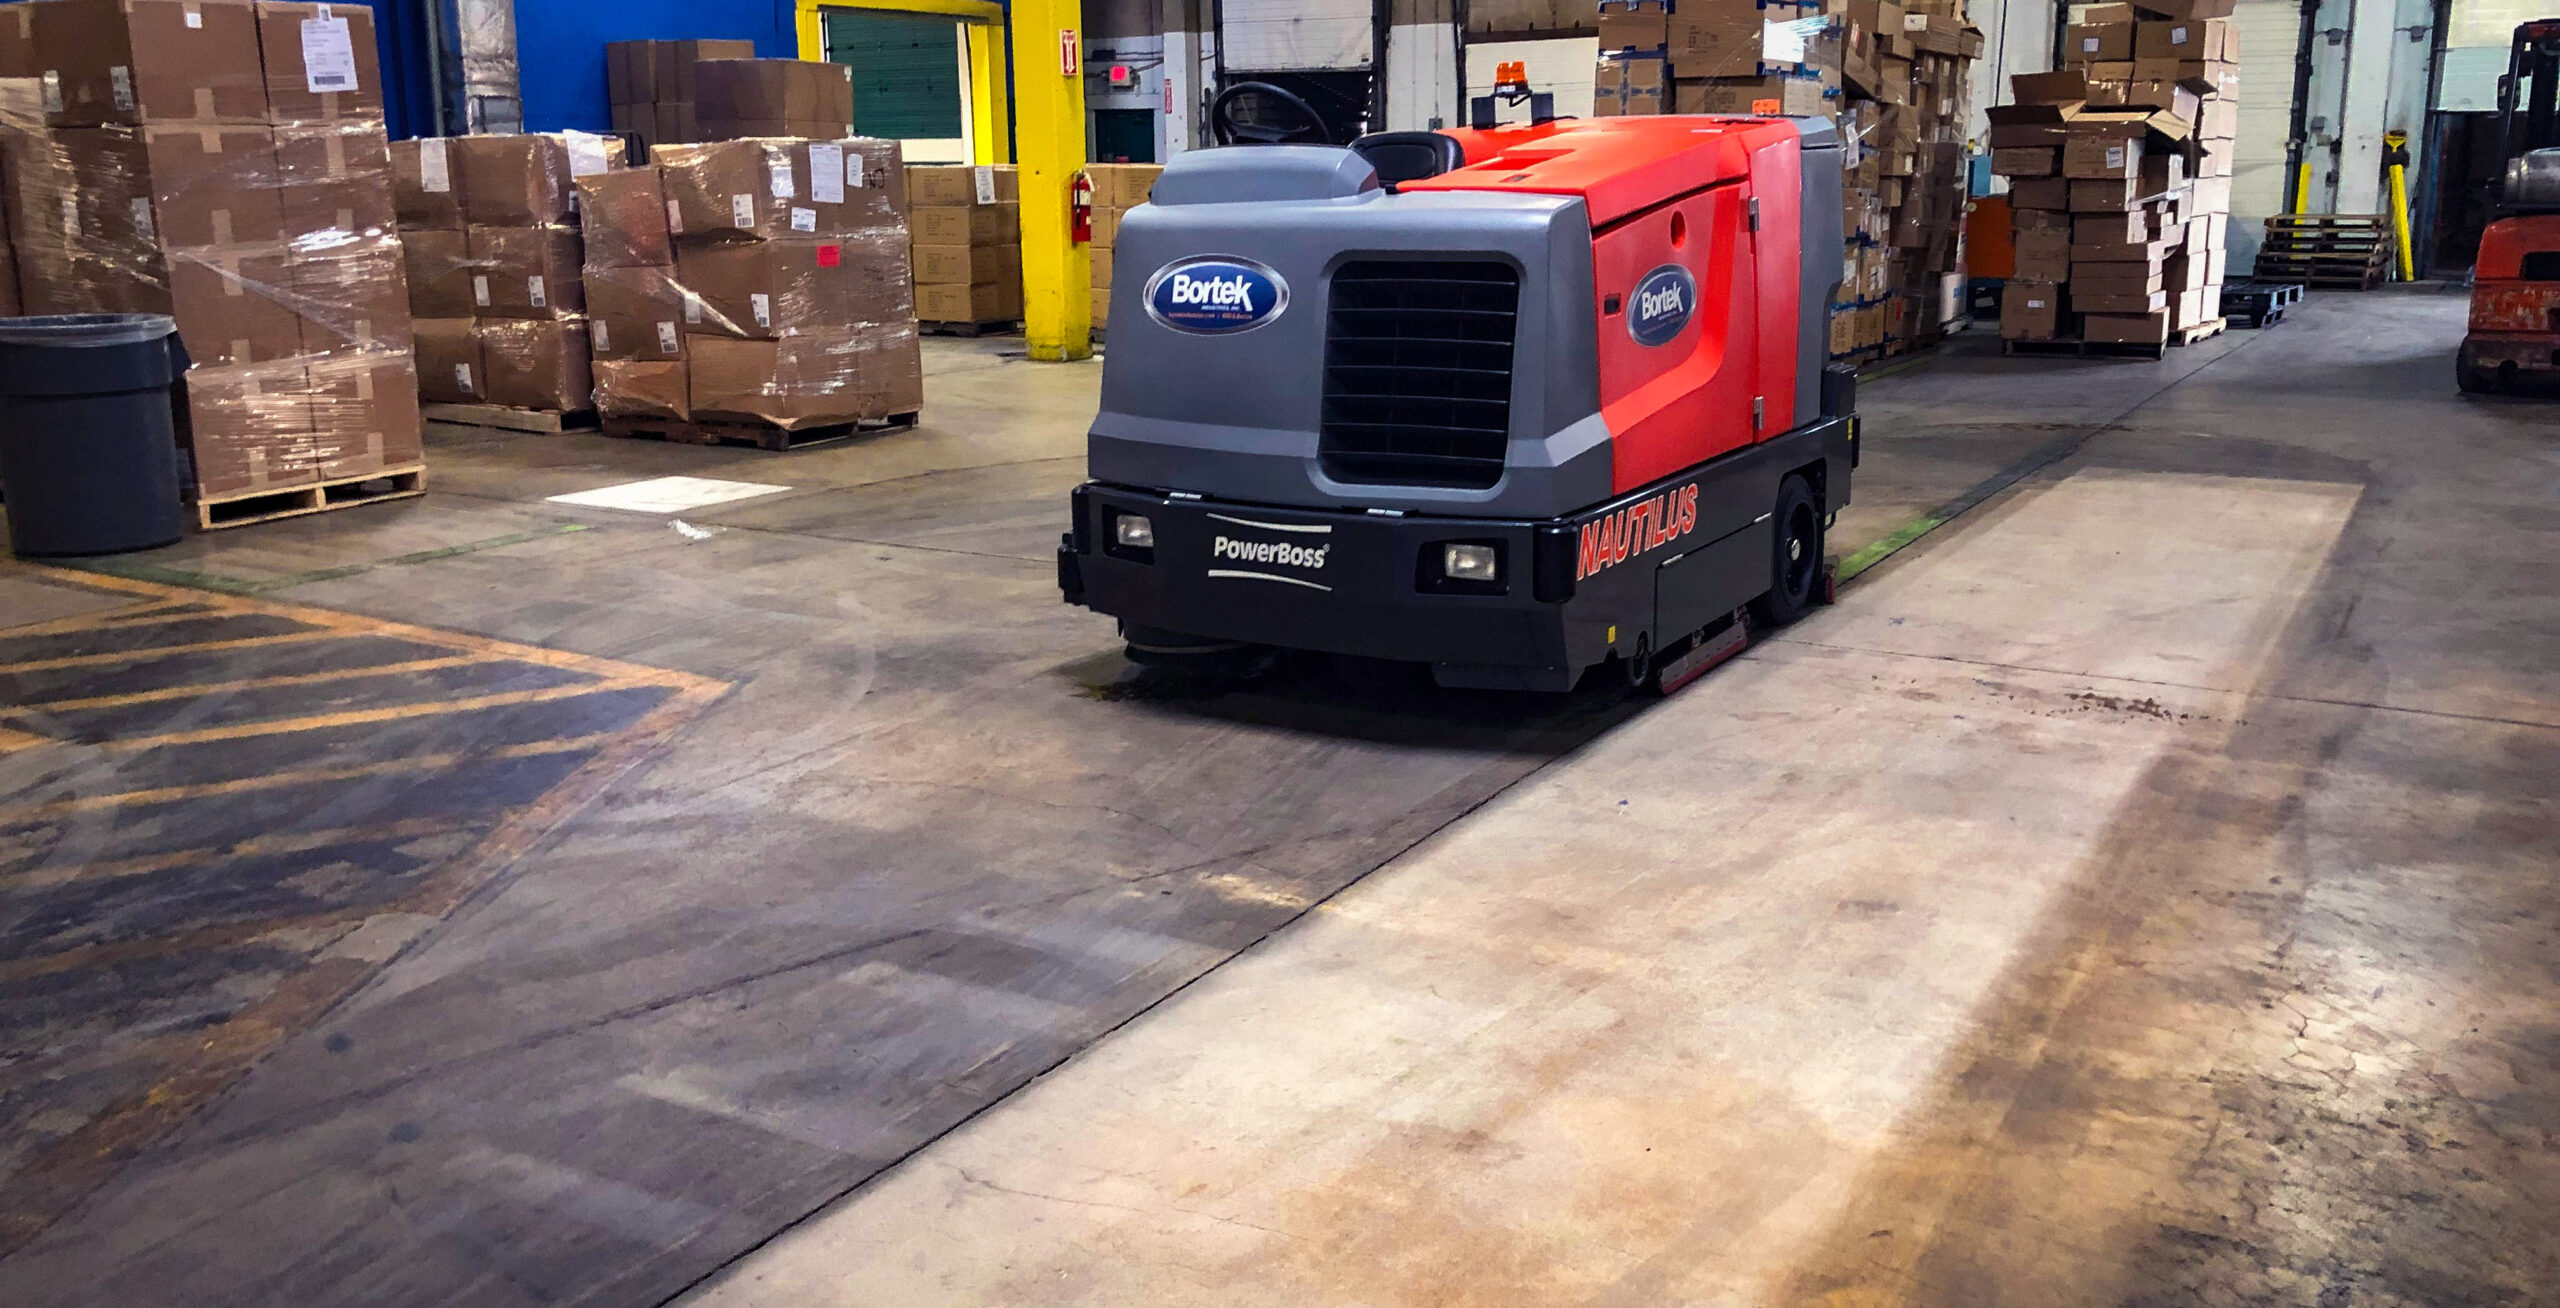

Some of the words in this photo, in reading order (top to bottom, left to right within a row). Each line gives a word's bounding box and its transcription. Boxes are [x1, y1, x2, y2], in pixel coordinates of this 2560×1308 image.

[1171, 274, 1253, 312] Bortek
[1641, 281, 1683, 320] Bortek
[1576, 482, 1699, 581] NAUTILUS
